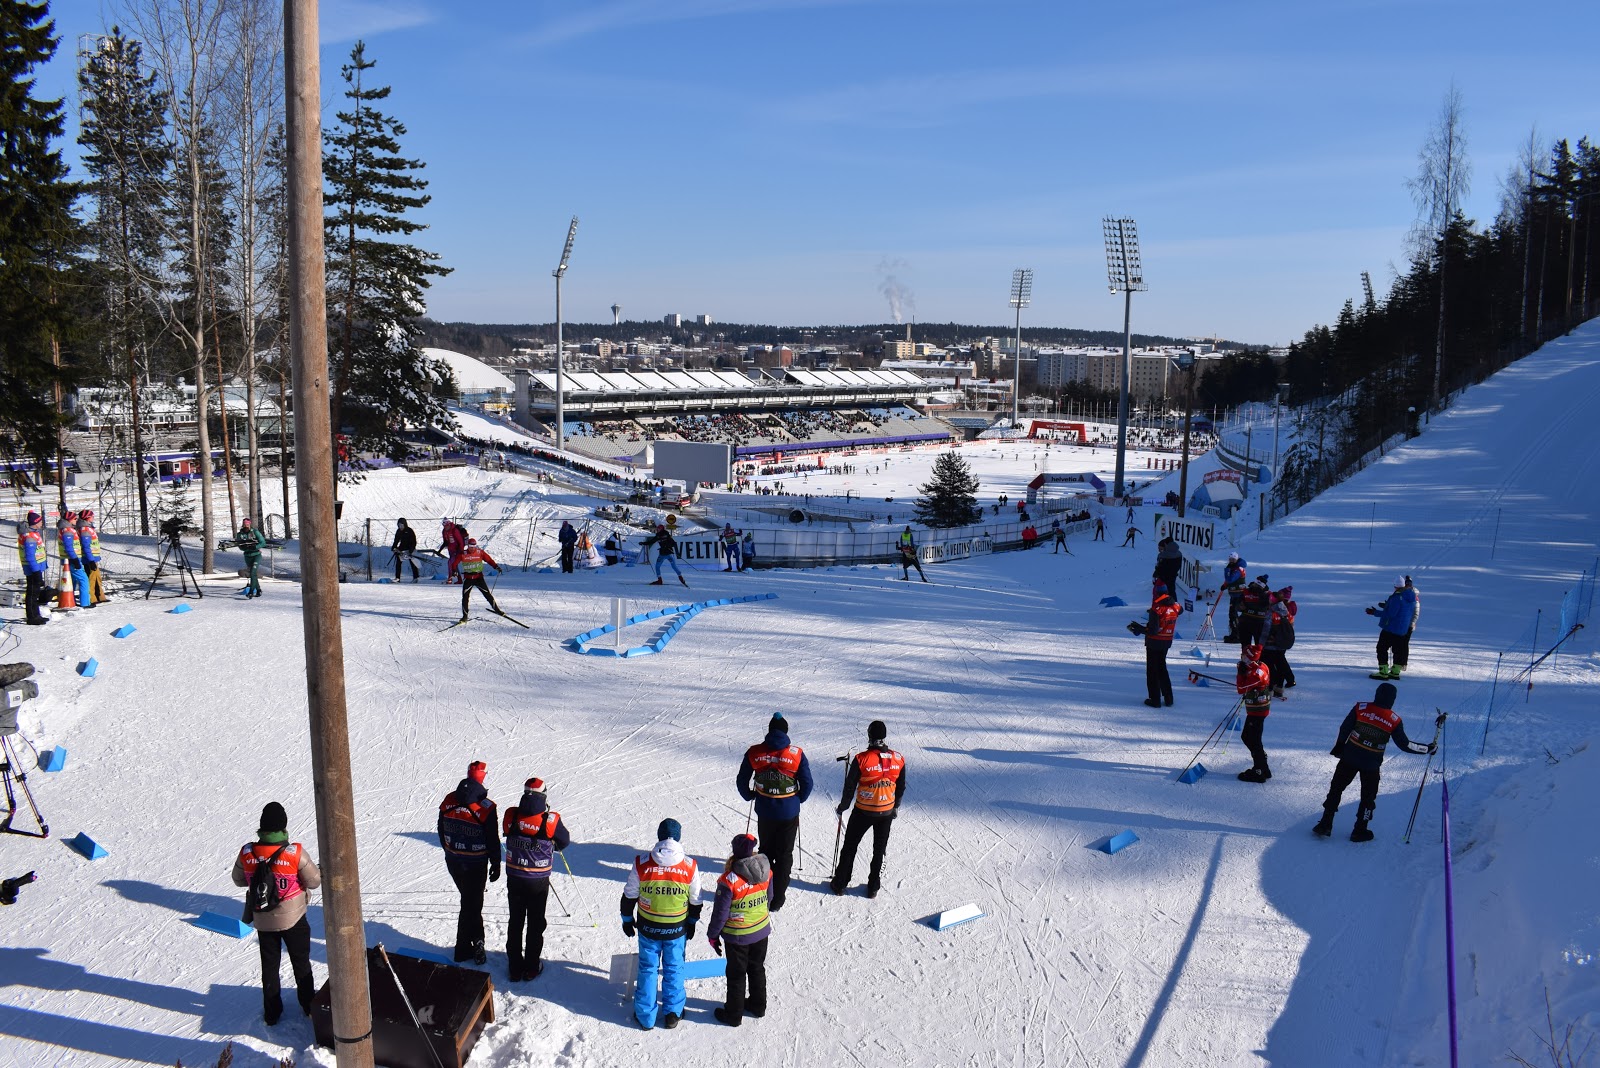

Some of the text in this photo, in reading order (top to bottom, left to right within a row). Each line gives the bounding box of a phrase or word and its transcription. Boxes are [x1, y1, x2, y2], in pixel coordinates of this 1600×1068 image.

[1168, 521, 1211, 548] VELTINS
[676, 541, 738, 559] VELTIN
[922, 545, 944, 559] VELTINS
[950, 541, 970, 556] VELTINS
[975, 538, 992, 552] VELTINS
[644, 866, 689, 877] VIESSMANN
